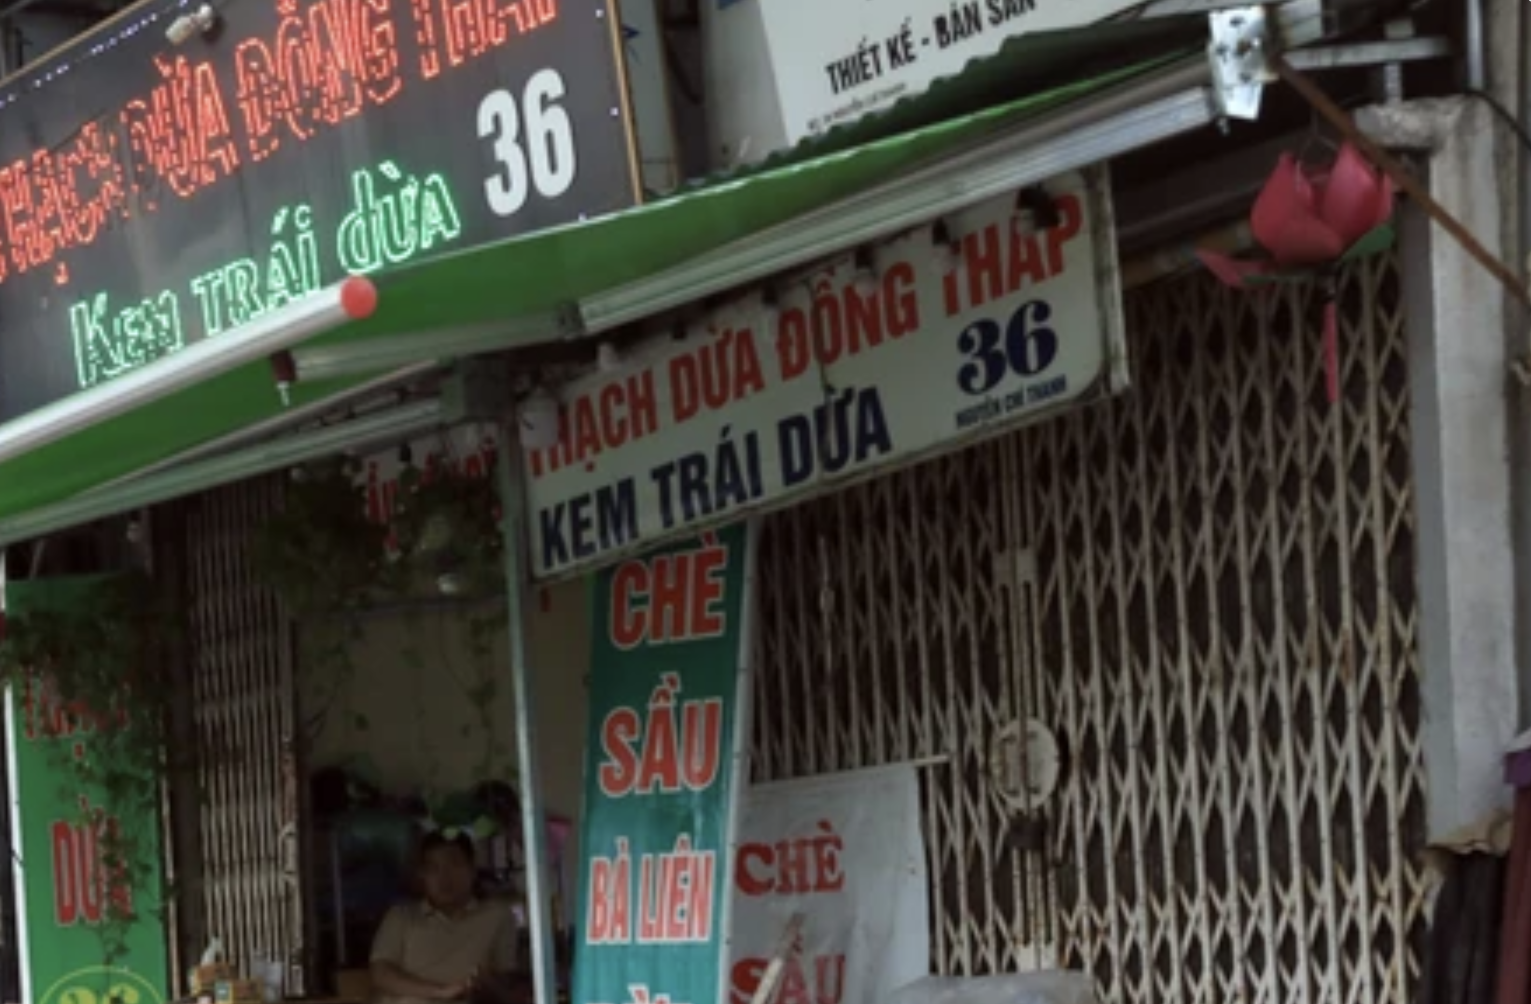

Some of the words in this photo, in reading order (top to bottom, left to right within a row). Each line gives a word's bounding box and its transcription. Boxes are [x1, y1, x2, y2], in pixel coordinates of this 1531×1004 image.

[477, 68, 576, 217] 36
[529, 366, 657, 480] HẠCH
[668, 322, 766, 424] DỪA
[956, 299, 1059, 396] 36
[539, 476, 639, 570] KEM
[651, 424, 764, 529] TRÁI
[777, 383, 892, 488] DỪA
[611, 528, 727, 650] CHÈ
[636, 834, 715, 943] LIÊN
[735, 819, 845, 895] CHÈ
